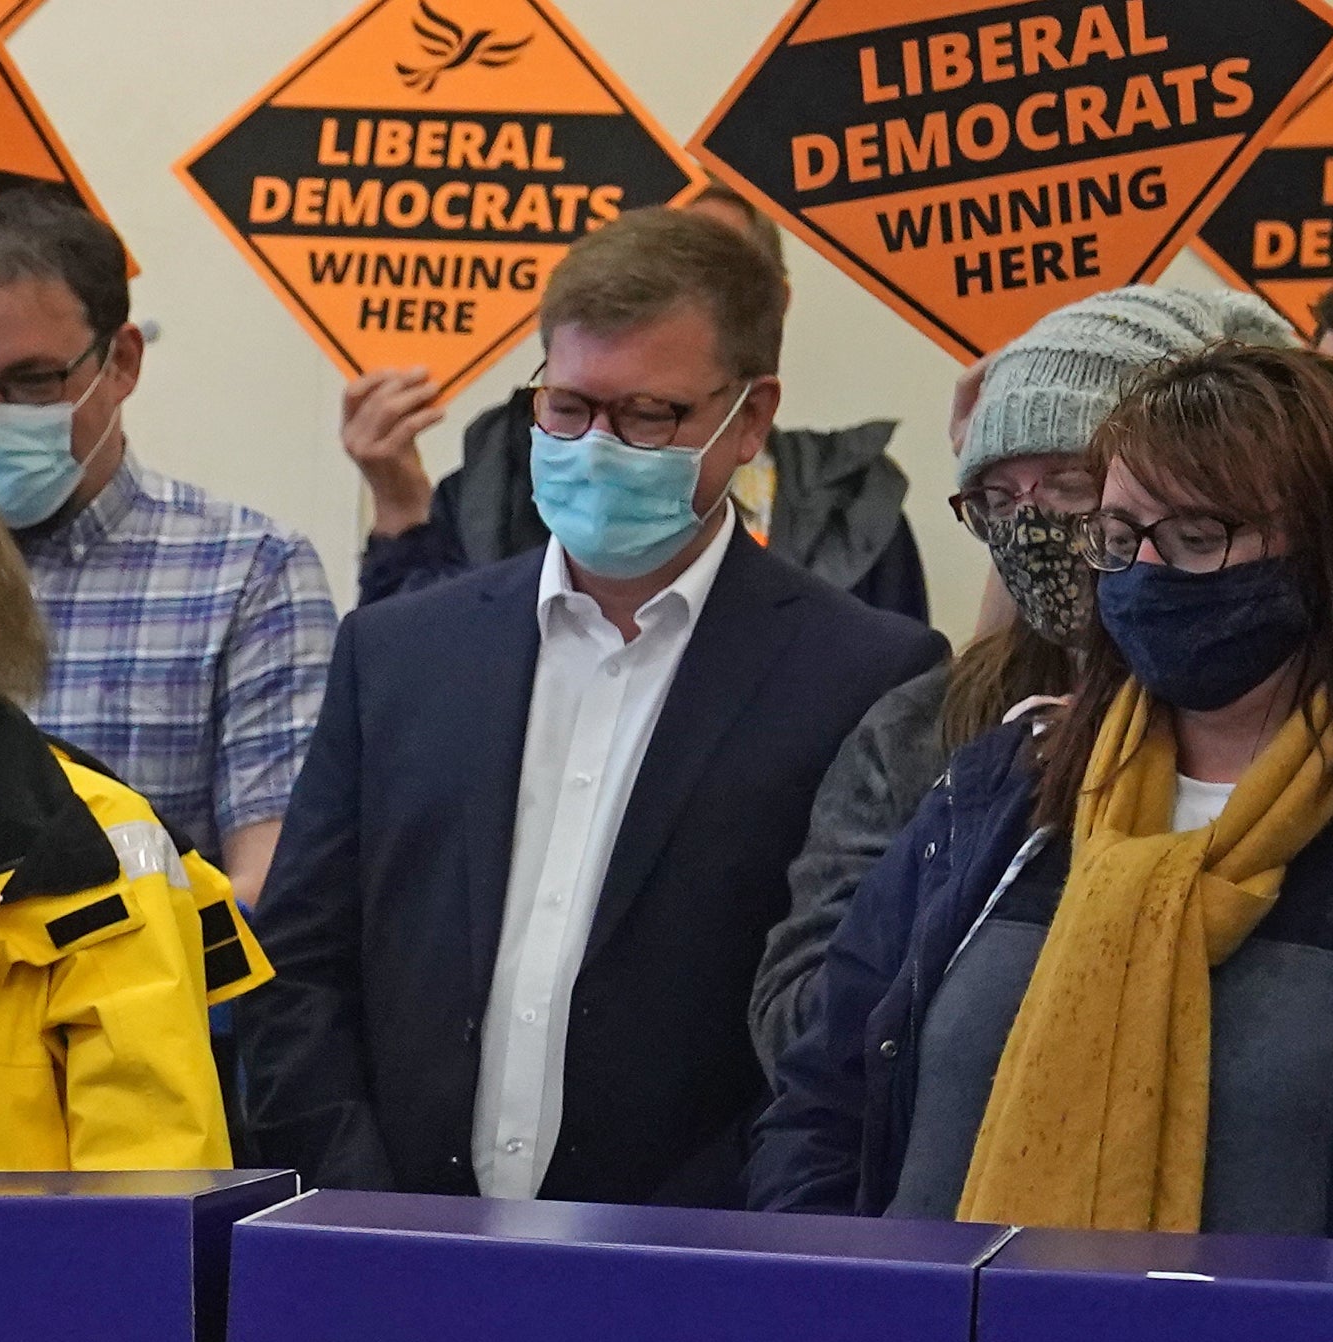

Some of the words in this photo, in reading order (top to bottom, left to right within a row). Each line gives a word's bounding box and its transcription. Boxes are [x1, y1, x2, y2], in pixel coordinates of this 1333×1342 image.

[859, 0, 1168, 104] LIBERAL
[317, 118, 565, 172] LIBERAL
[791, 58, 1255, 193] DEMOCRATS
[249, 177, 625, 233] DEMOCRATS
[877, 166, 1168, 253] WINNING
[308, 250, 537, 290] WINNING
[955, 234, 1101, 298] HERE
[357, 298, 475, 334] HERE
